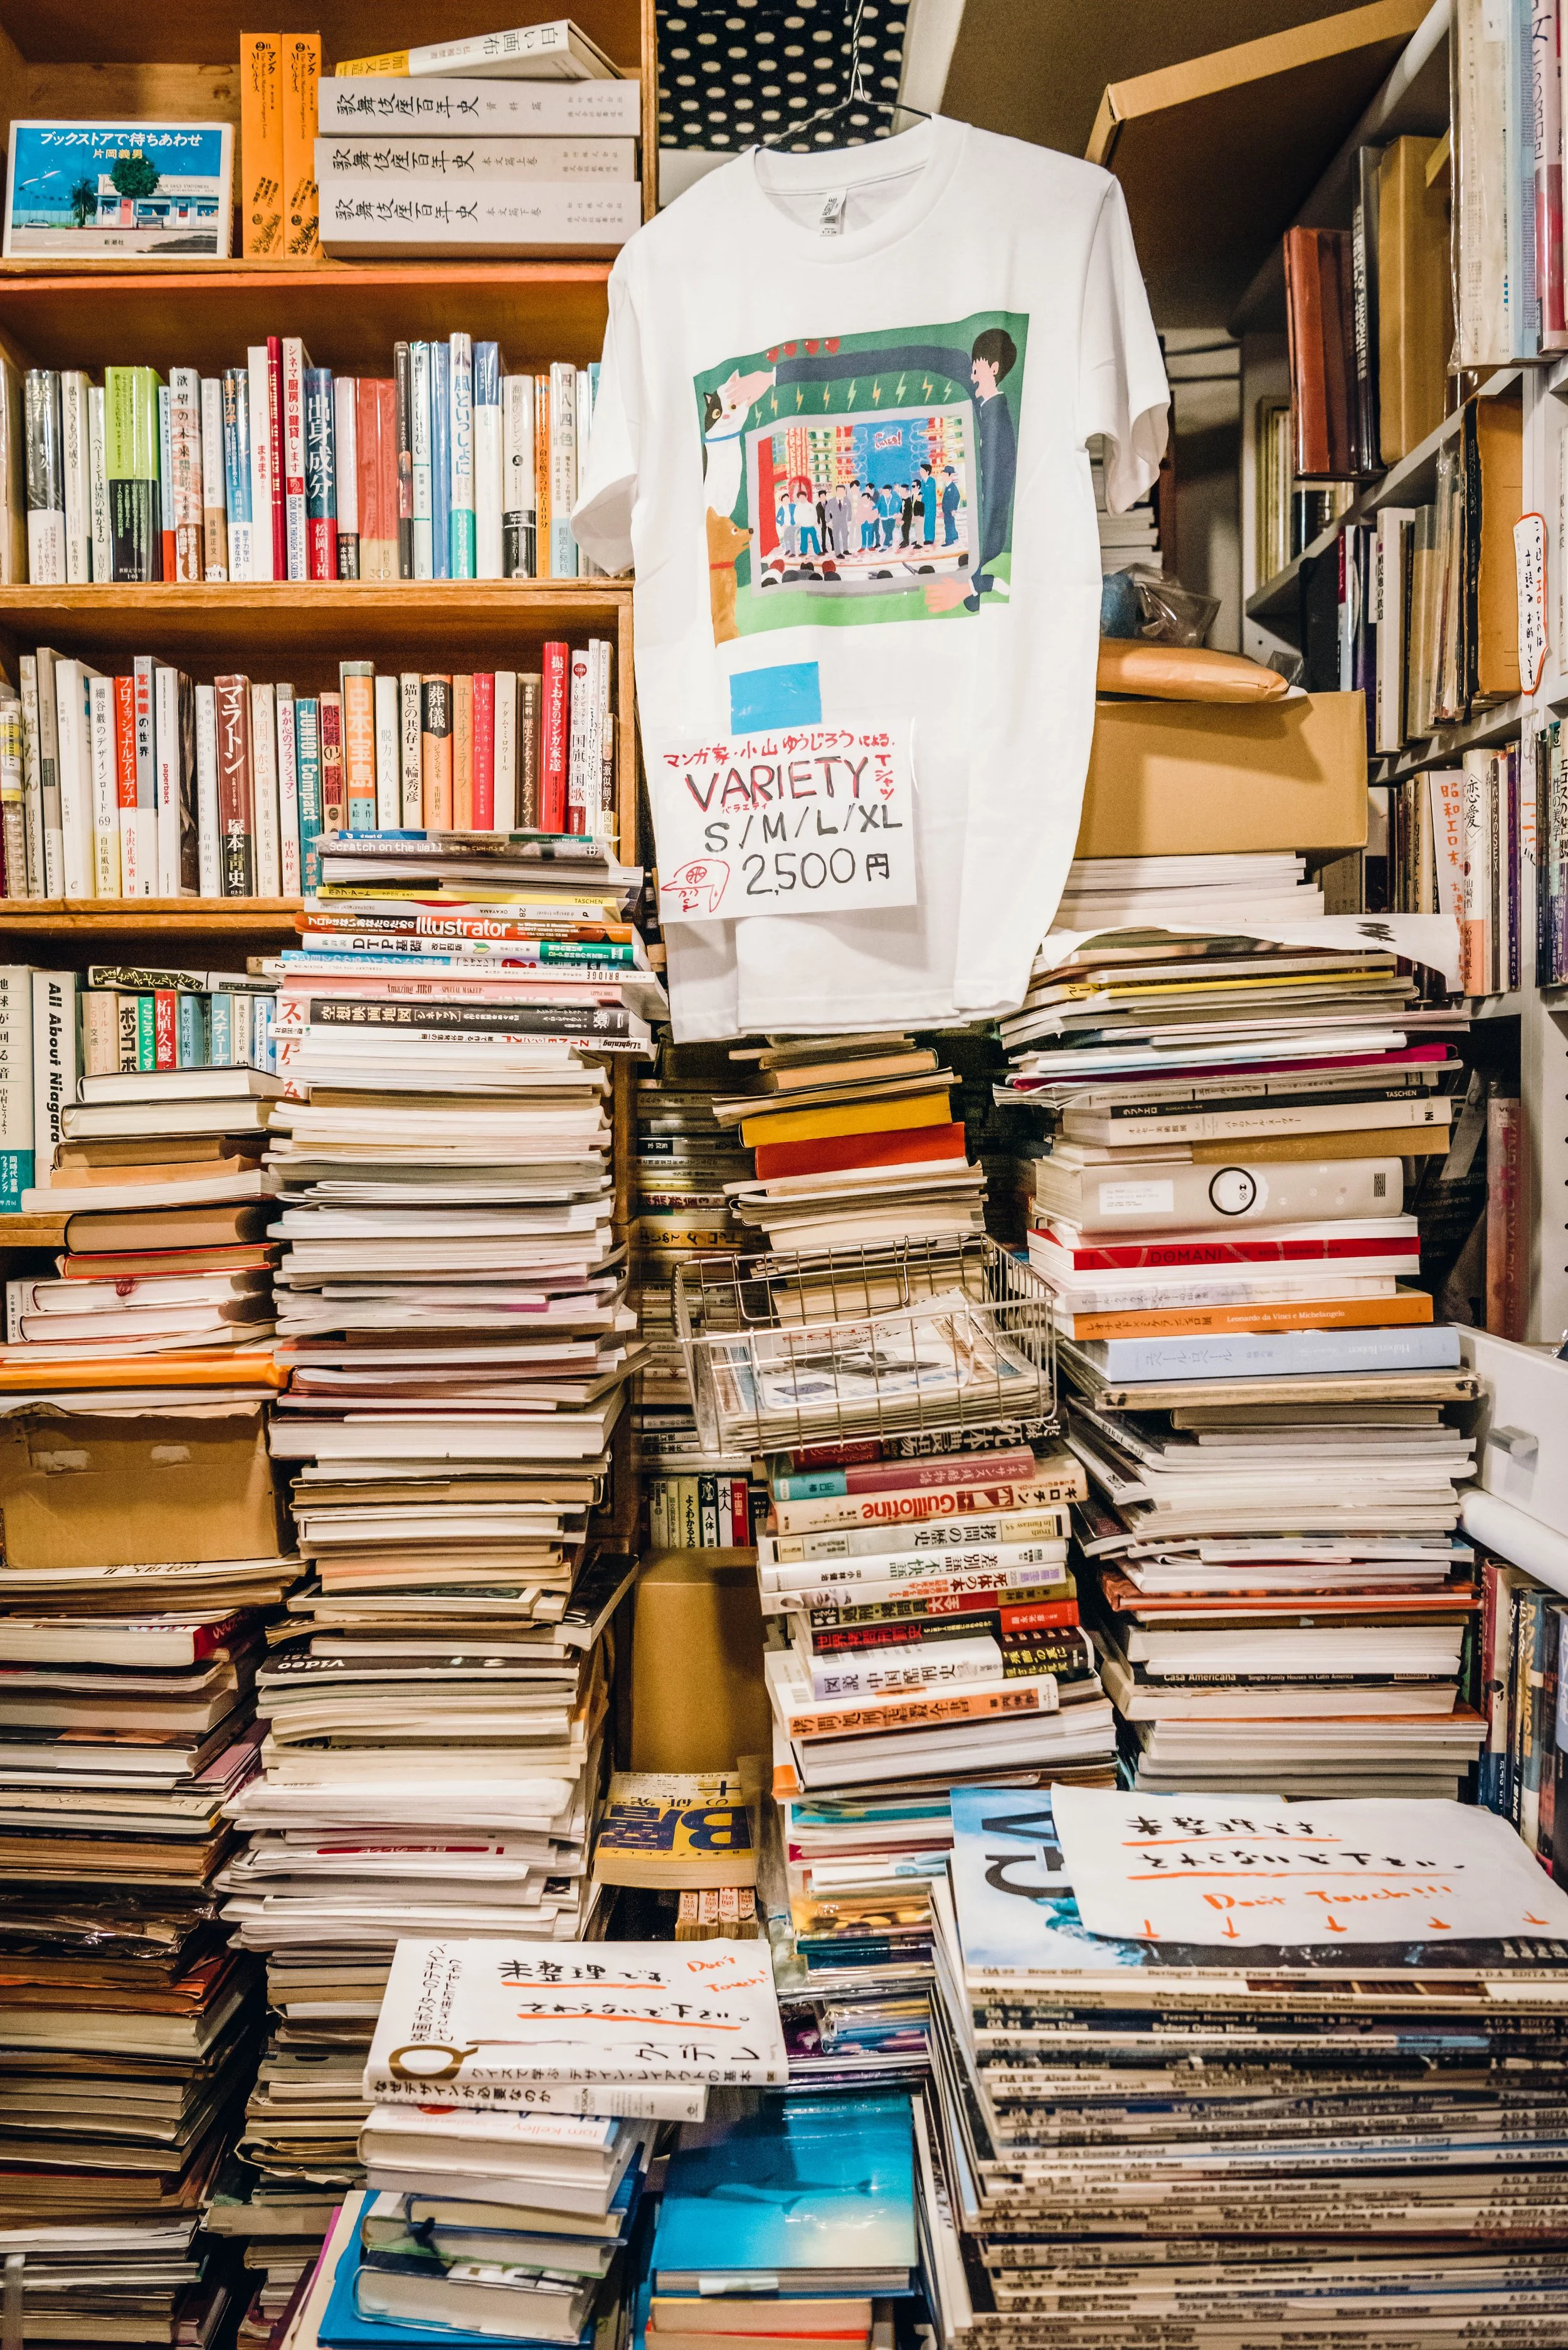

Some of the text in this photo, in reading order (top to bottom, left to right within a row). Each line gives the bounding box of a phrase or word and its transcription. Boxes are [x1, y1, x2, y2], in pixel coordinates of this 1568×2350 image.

[484, 28, 558, 55] 白い画布
[351, 55, 403, 76] 加山又造
[336, 93, 480, 119] 歌舞伎座百年史
[41, 130, 203, 147] ブックストアで待ちあわせ
[93, 149, 143, 159] 片岡義男
[332, 148, 475, 174] 歌舞伎座百年史
[336, 198, 479, 224] 歌舞伎座百年史
[225, 378, 236, 425] 量子力学
[288, 346, 300, 474] シネマ厨房の鍵貸します
[559, 373, 573, 447] 四人四色
[68, 386, 78, 470] 私というものの成立
[455, 375, 470, 476] 風といっしょに
[309, 395, 332, 500] 出身成分
[209, 519, 218, 556] 後藤正文
[315, 524, 329, 578] 松岡圭祐
[558, 526, 569, 573] 創造と発見
[137, 673, 150, 758] 宮崎駿の世界
[428, 686, 445, 729] 葬儀
[549, 656, 564, 772] 撮っておきのマンガ家達
[219, 685, 245, 775] マラトン
[255, 688, 268, 775] 火の国の恋
[349, 687, 374, 788] 日本宝島
[405, 683, 420, 804] 猫との共存 三輪秀彦
[95, 688, 110, 827] 細谷巖のデザインロード69
[281, 706, 295, 800] わが心のフラッシュマン
[300, 710, 319, 822] JUNIOR Compact
[381, 729, 393, 784] 脱力の人
[571, 734, 586, 802] 国旗と国歌
[523, 718, 533, 825] 歴史をあるく、文学をゆく
[685, 756, 869, 812] VARIETY
[874, 754, 894, 800] Tシャツ
[722, 802, 768, 814] バラエティ
[1466, 779, 1481, 829] 恋愛
[100, 836, 110, 885] 自伝風語り
[125, 827, 136, 864] 小沢正光
[203, 832, 212, 875] 白井明大
[284, 840, 294, 871] 中島梓
[329, 842, 377, 852] Scratch
[379, 843, 393, 852] on
[394, 843, 414, 852] the
[417, 843, 443, 853] Wall
[307, 915, 512, 938] プロではないあなたのための Illustrator
[519, 907, 526, 918] 28
[352, 938, 422, 952] DTP基礎
[386, 984, 432, 994] Amazing JIRO
[586, 971, 619, 981] BRIDGE
[320, 1006, 411, 1023] 空想映画地図
[602, 1039, 638, 1049] Lightning
[46, 982, 63, 1144] All About Niagara
[1122, 1089, 1417, 1117] ラファエロ TASCHEN
[1128, 1123, 1188, 1135] オルセー美術館展
[1, 1156, 9, 1192] ウォッチング
[9, 1156, 18, 1193] 同時代音楽
[1150, 1249, 1222, 1266] DOMANI
[1086, 1316, 1213, 1332] レオナルド×ミケランジェロ展
[1226, 1314, 1260, 1324] Leonardo
[1273, 1312, 1291, 1321] Vinci
[1298, 1309, 1345, 1320] Michelangelo
[861, 1485, 1079, 1520] ギロチン Guillotine
[913, 1524, 999, 1546] 拷問の歴史
[1014, 1519, 1052, 1531] In Fantasy
[1030, 1527, 1052, 1536] Truth
[889, 1551, 999, 1578] 差別語不快語
[950, 1572, 1009, 1593] 死体の本
[277, 1659, 345, 1670] Video
[824, 1663, 956, 1694] 図説 中国酷刑史
[630, 1795, 729, 1809] の研究
[598, 1804, 753, 1851] B層
[686, 1956, 736, 1973] Don't
[704, 1970, 769, 1992] Touch!
[1192, 2024, 1223, 2033] Opera
[374, 2080, 551, 2102] なぜデザインが必要なのか
[472, 2068, 752, 2083] クイズで学ぶ デザイン・レイアウトの基本
[512, 2122, 597, 2140] Tom Kelley
